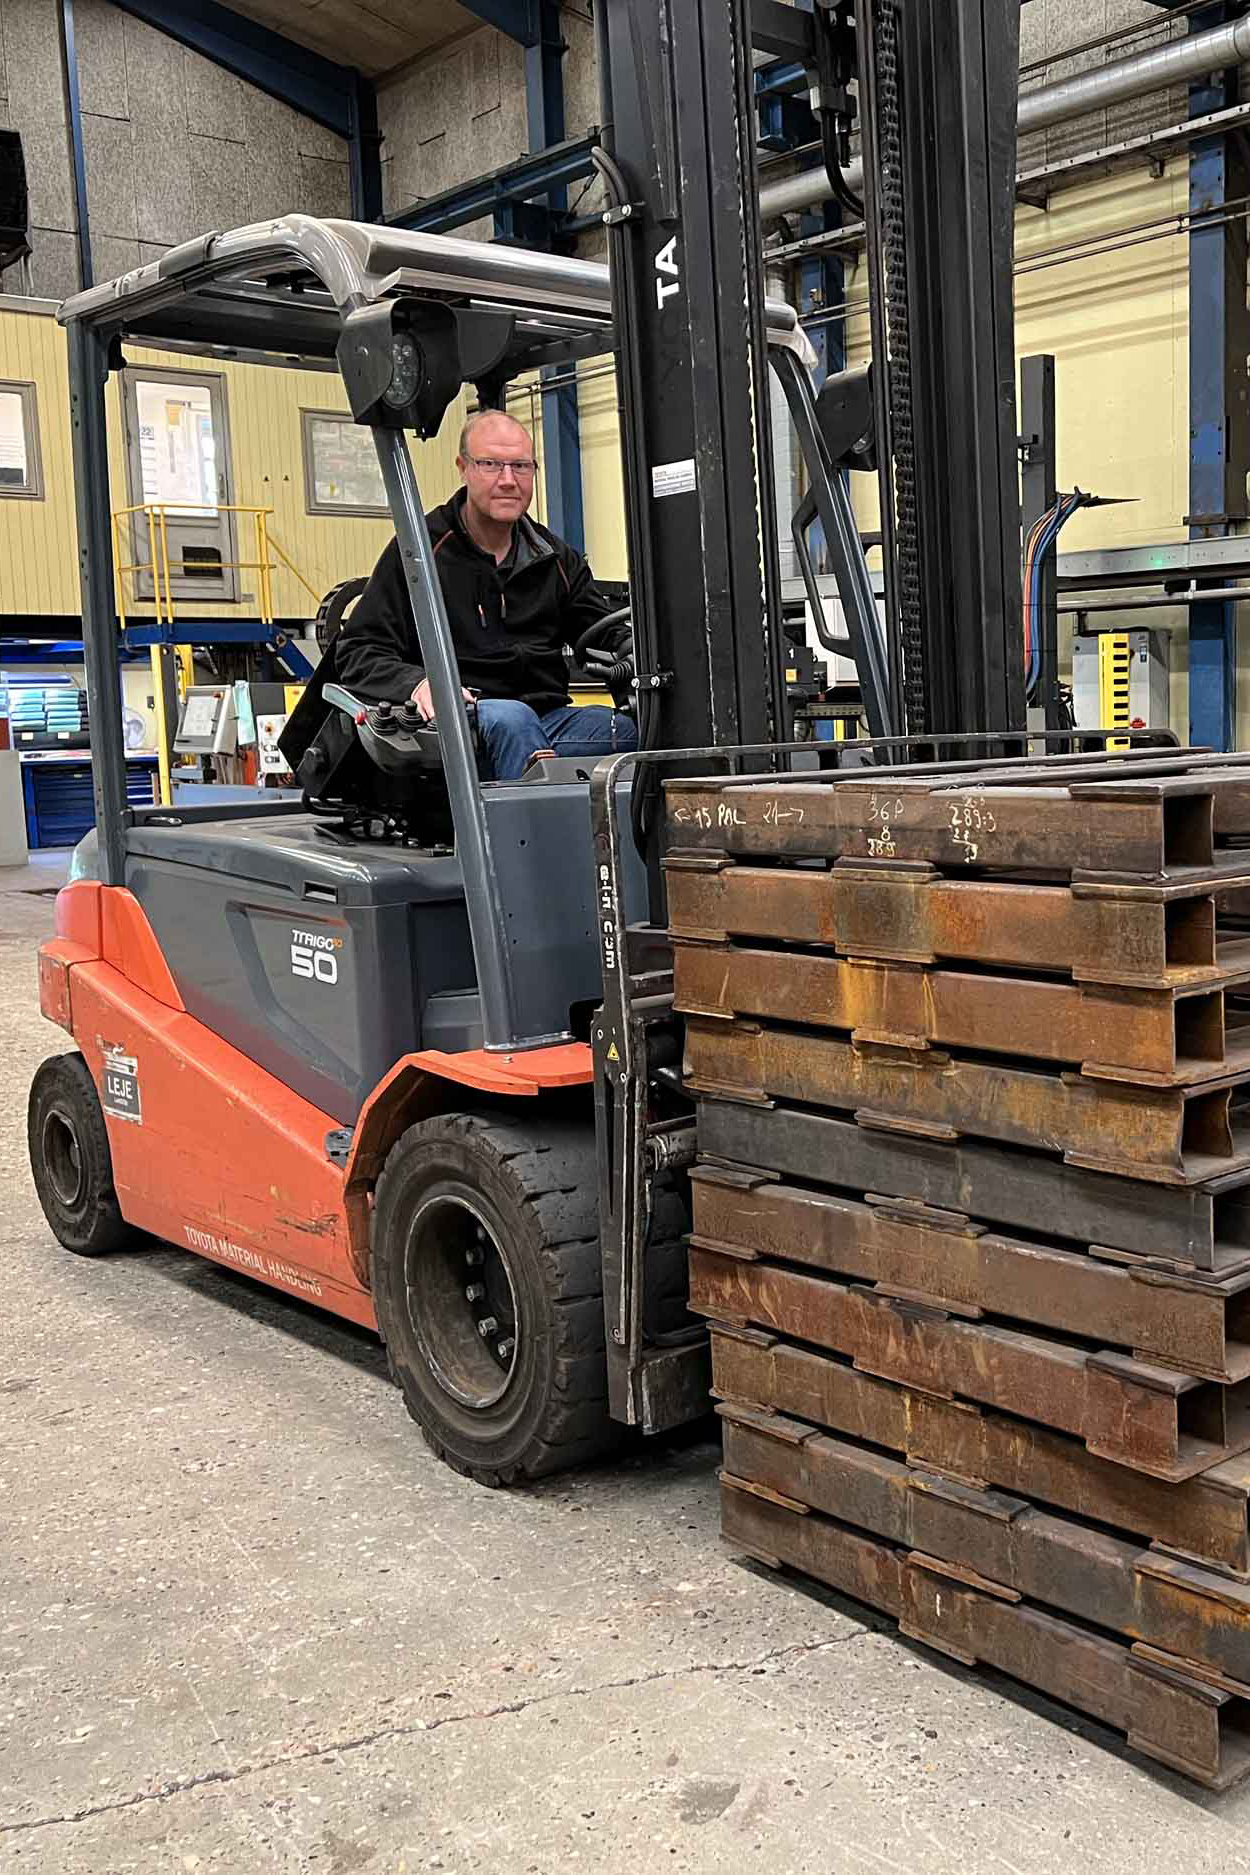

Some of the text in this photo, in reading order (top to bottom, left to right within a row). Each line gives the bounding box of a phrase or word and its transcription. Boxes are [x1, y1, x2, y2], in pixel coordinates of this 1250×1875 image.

[718, 803, 747, 827] PAL
[291, 944, 338, 985] 50
[107, 1075, 133, 1100] LEJE
[184, 1225, 219, 1254] TOYOTA
[219, 1239, 268, 1274] MATERIAL
